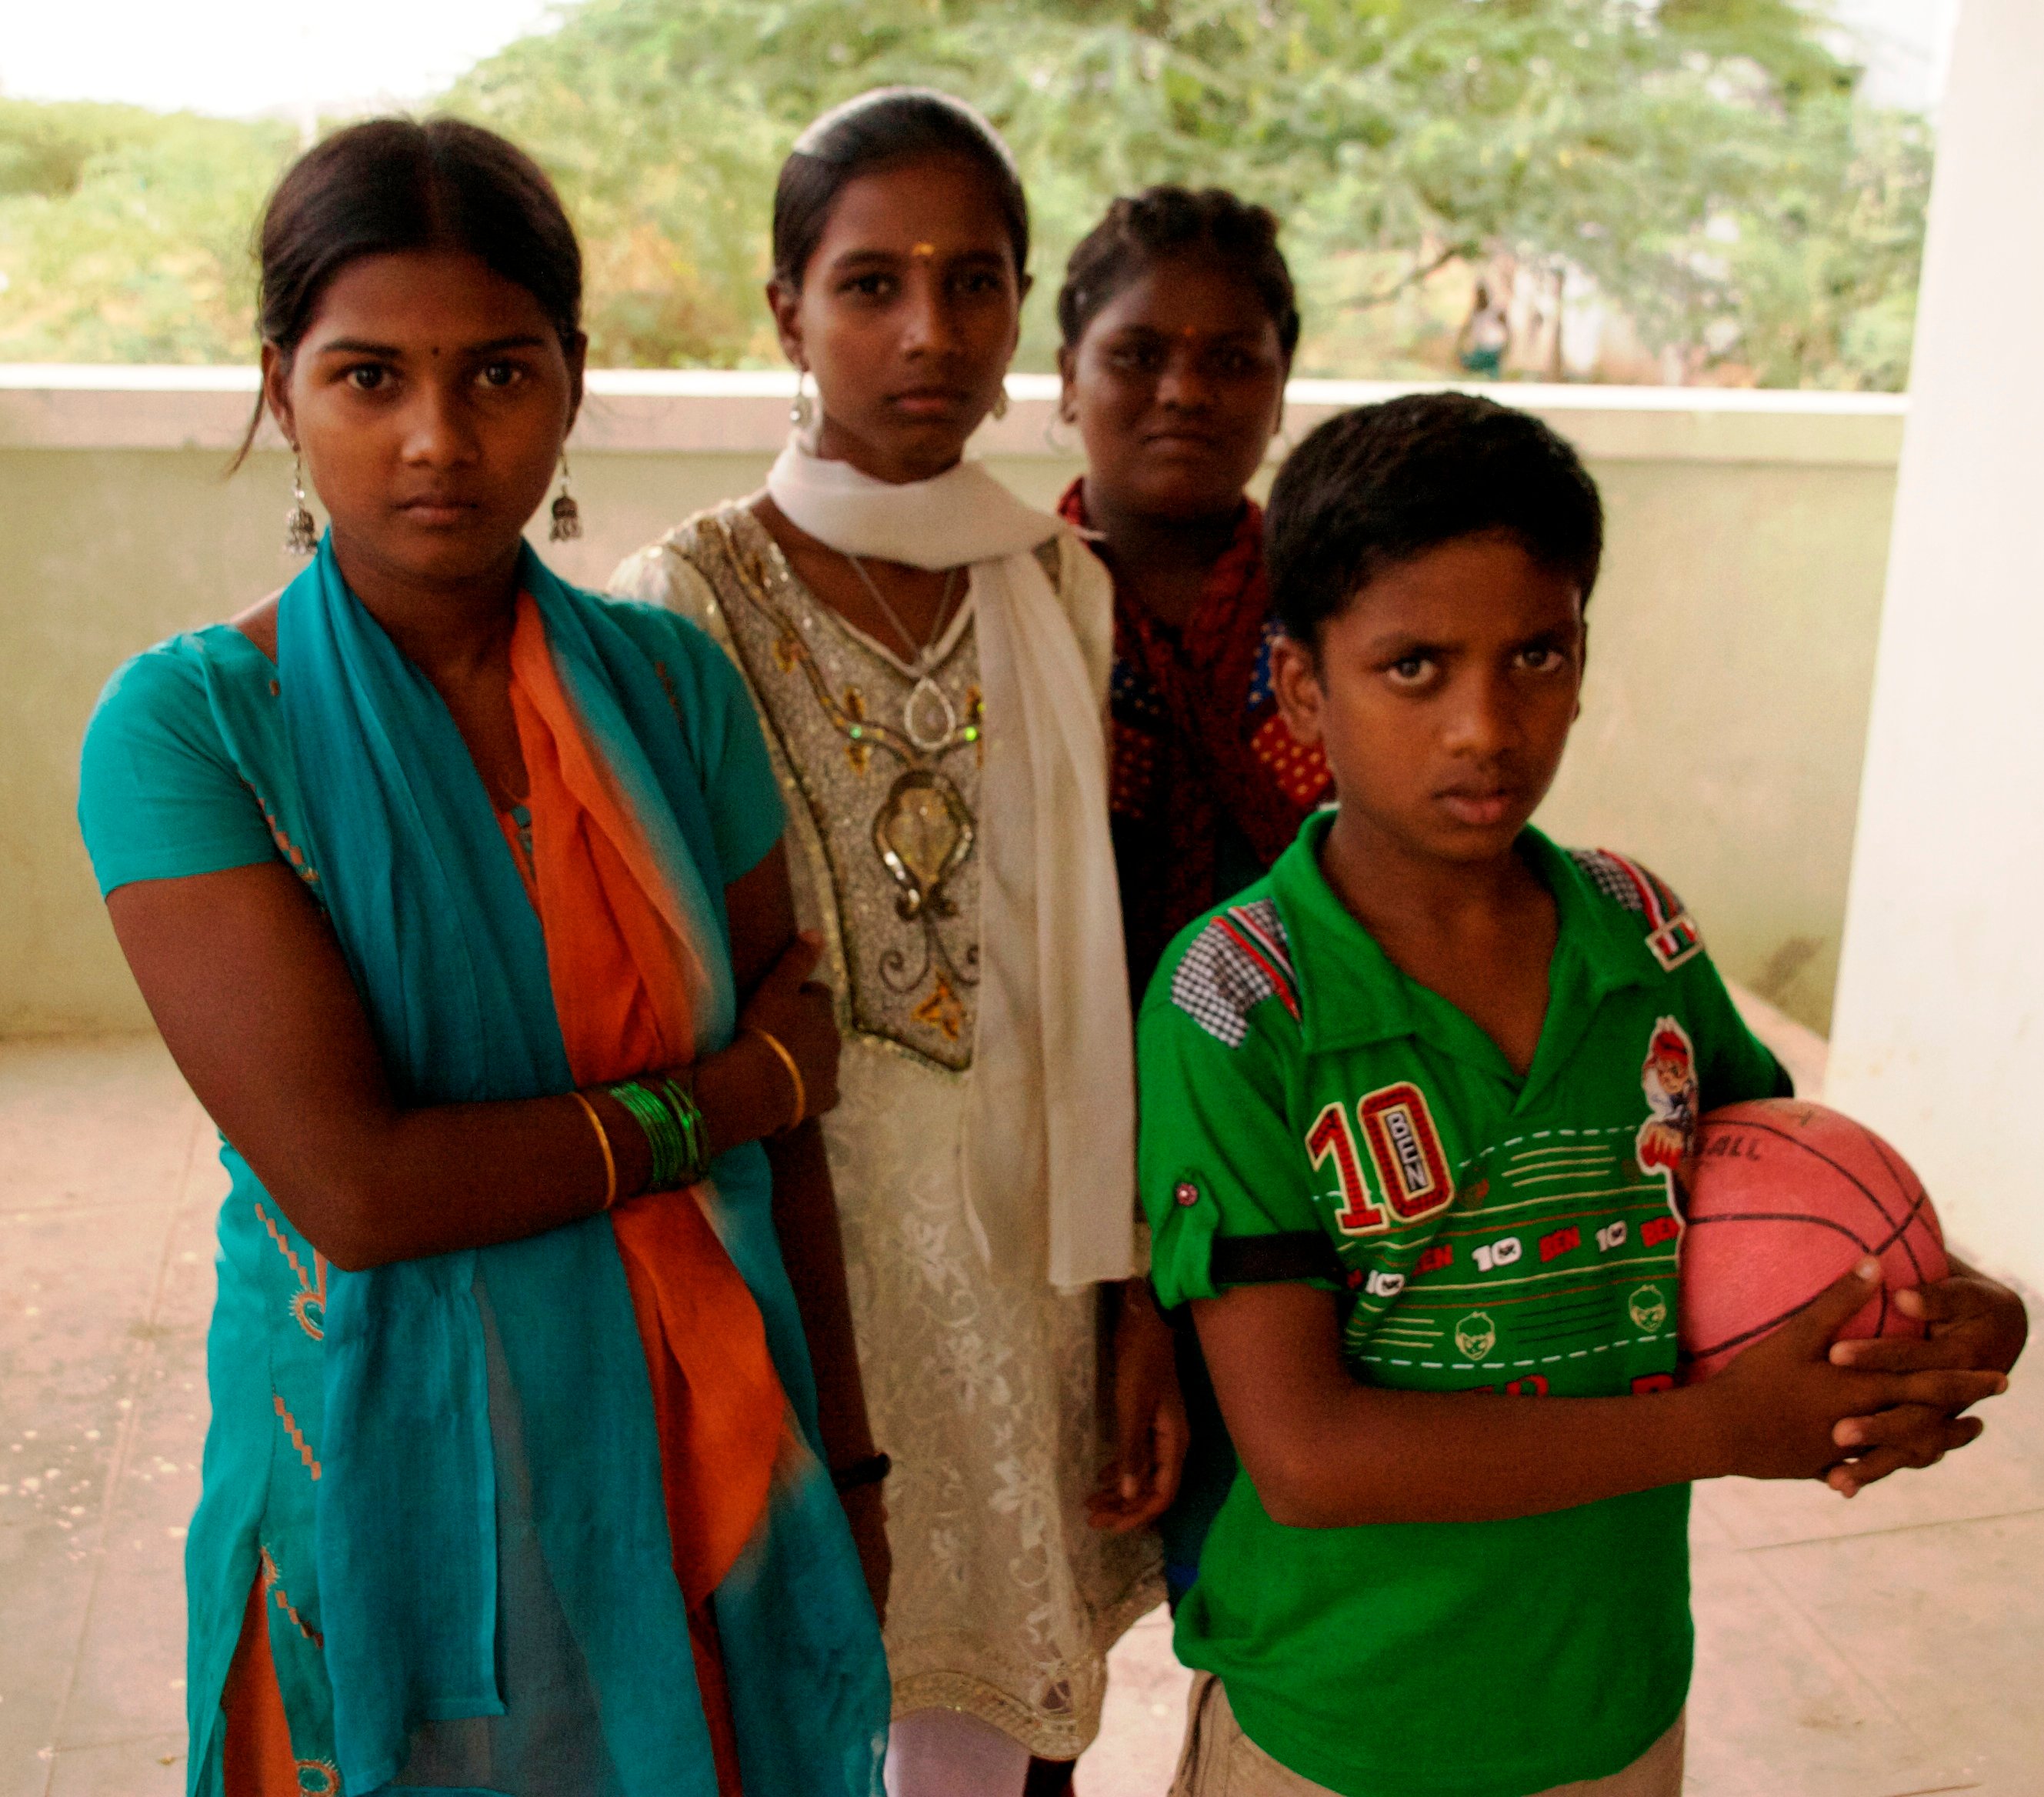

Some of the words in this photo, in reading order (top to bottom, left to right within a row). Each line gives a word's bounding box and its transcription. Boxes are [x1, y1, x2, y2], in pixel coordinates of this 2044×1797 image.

[1305, 1082, 1454, 1235] 10
[1385, 1112, 1429, 1191] BEN
[1365, 1269, 1405, 1298] 10
[1471, 1236, 1522, 1272] 10
[1539, 1225, 1581, 1263] BEN
[1596, 1220, 1628, 1252] 10
